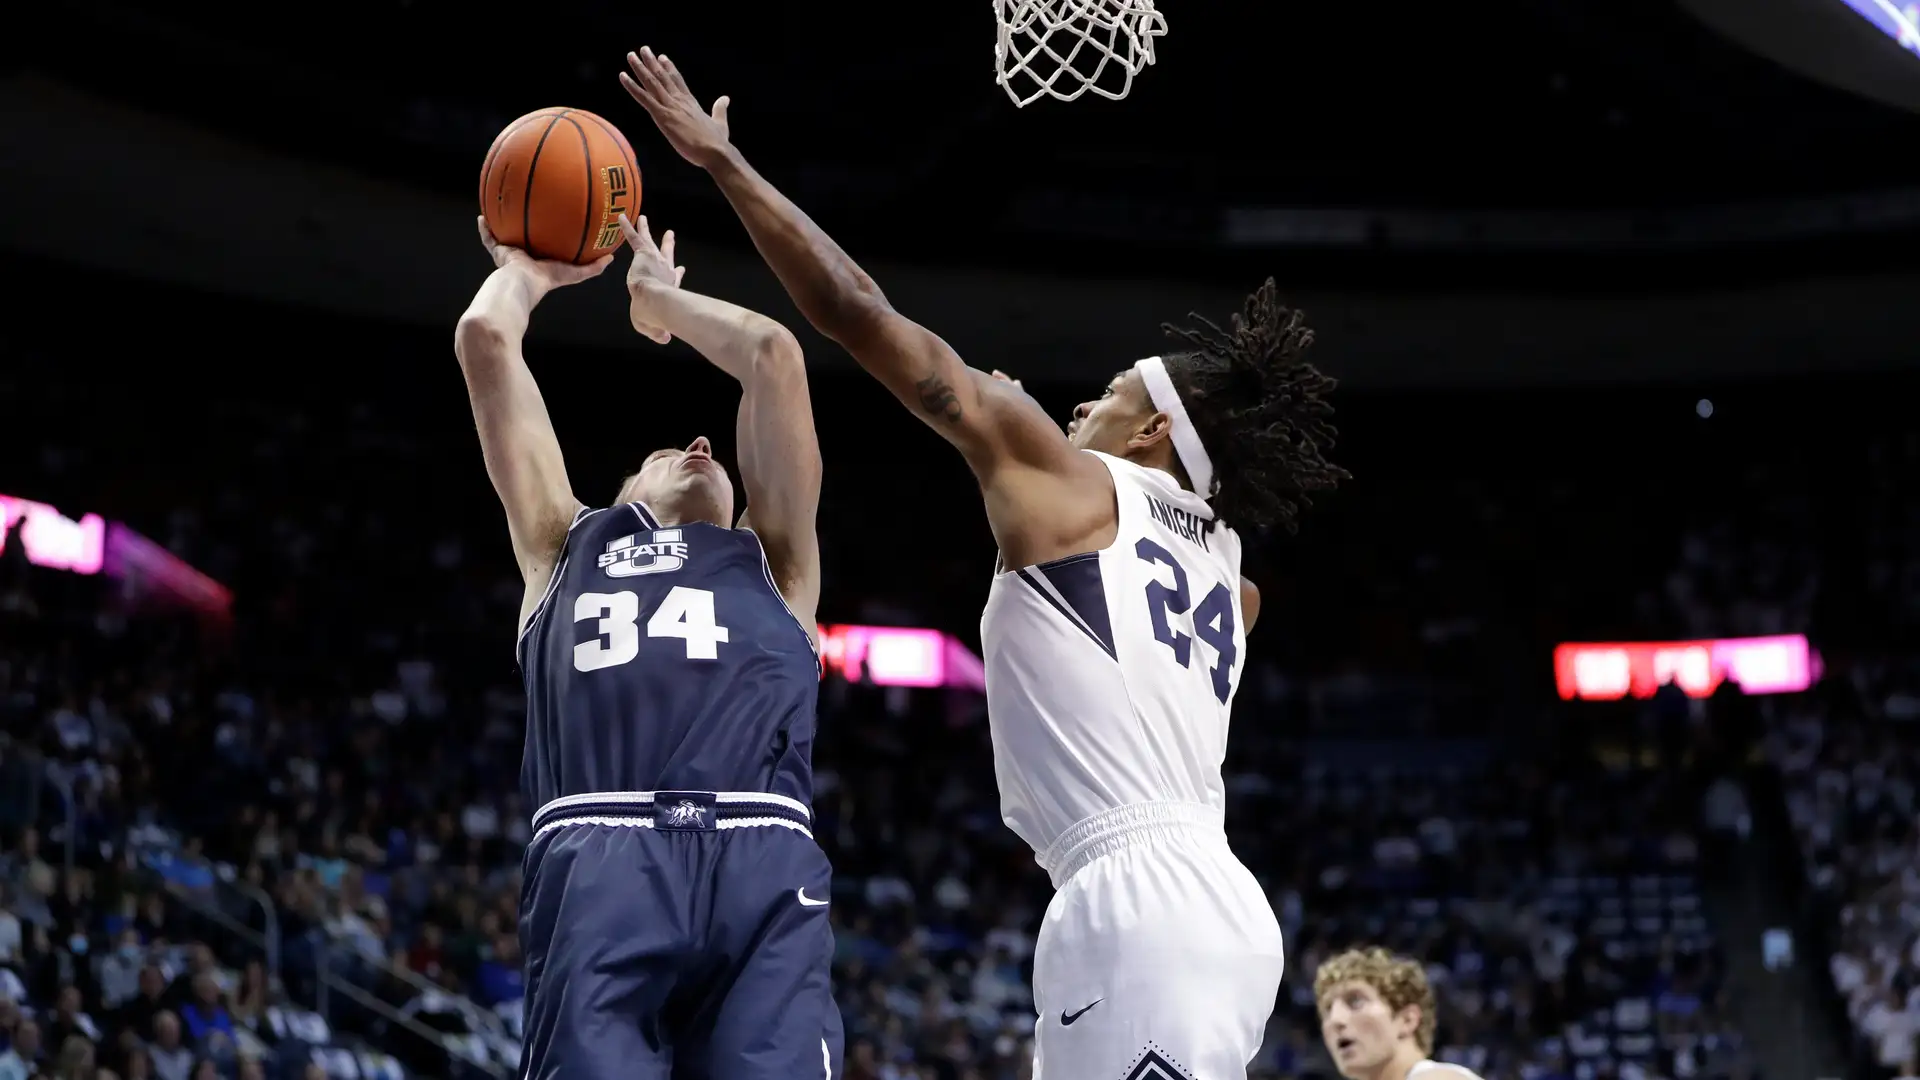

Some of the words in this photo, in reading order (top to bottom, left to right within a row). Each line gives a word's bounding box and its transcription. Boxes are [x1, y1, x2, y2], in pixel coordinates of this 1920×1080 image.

[593, 168, 609, 250] CHMPIONSHIP
[598, 543, 688, 568] STATE
[1143, 491, 1213, 553] KNIGHT
[573, 585, 729, 672] 34
[1135, 536, 1237, 706] 24
